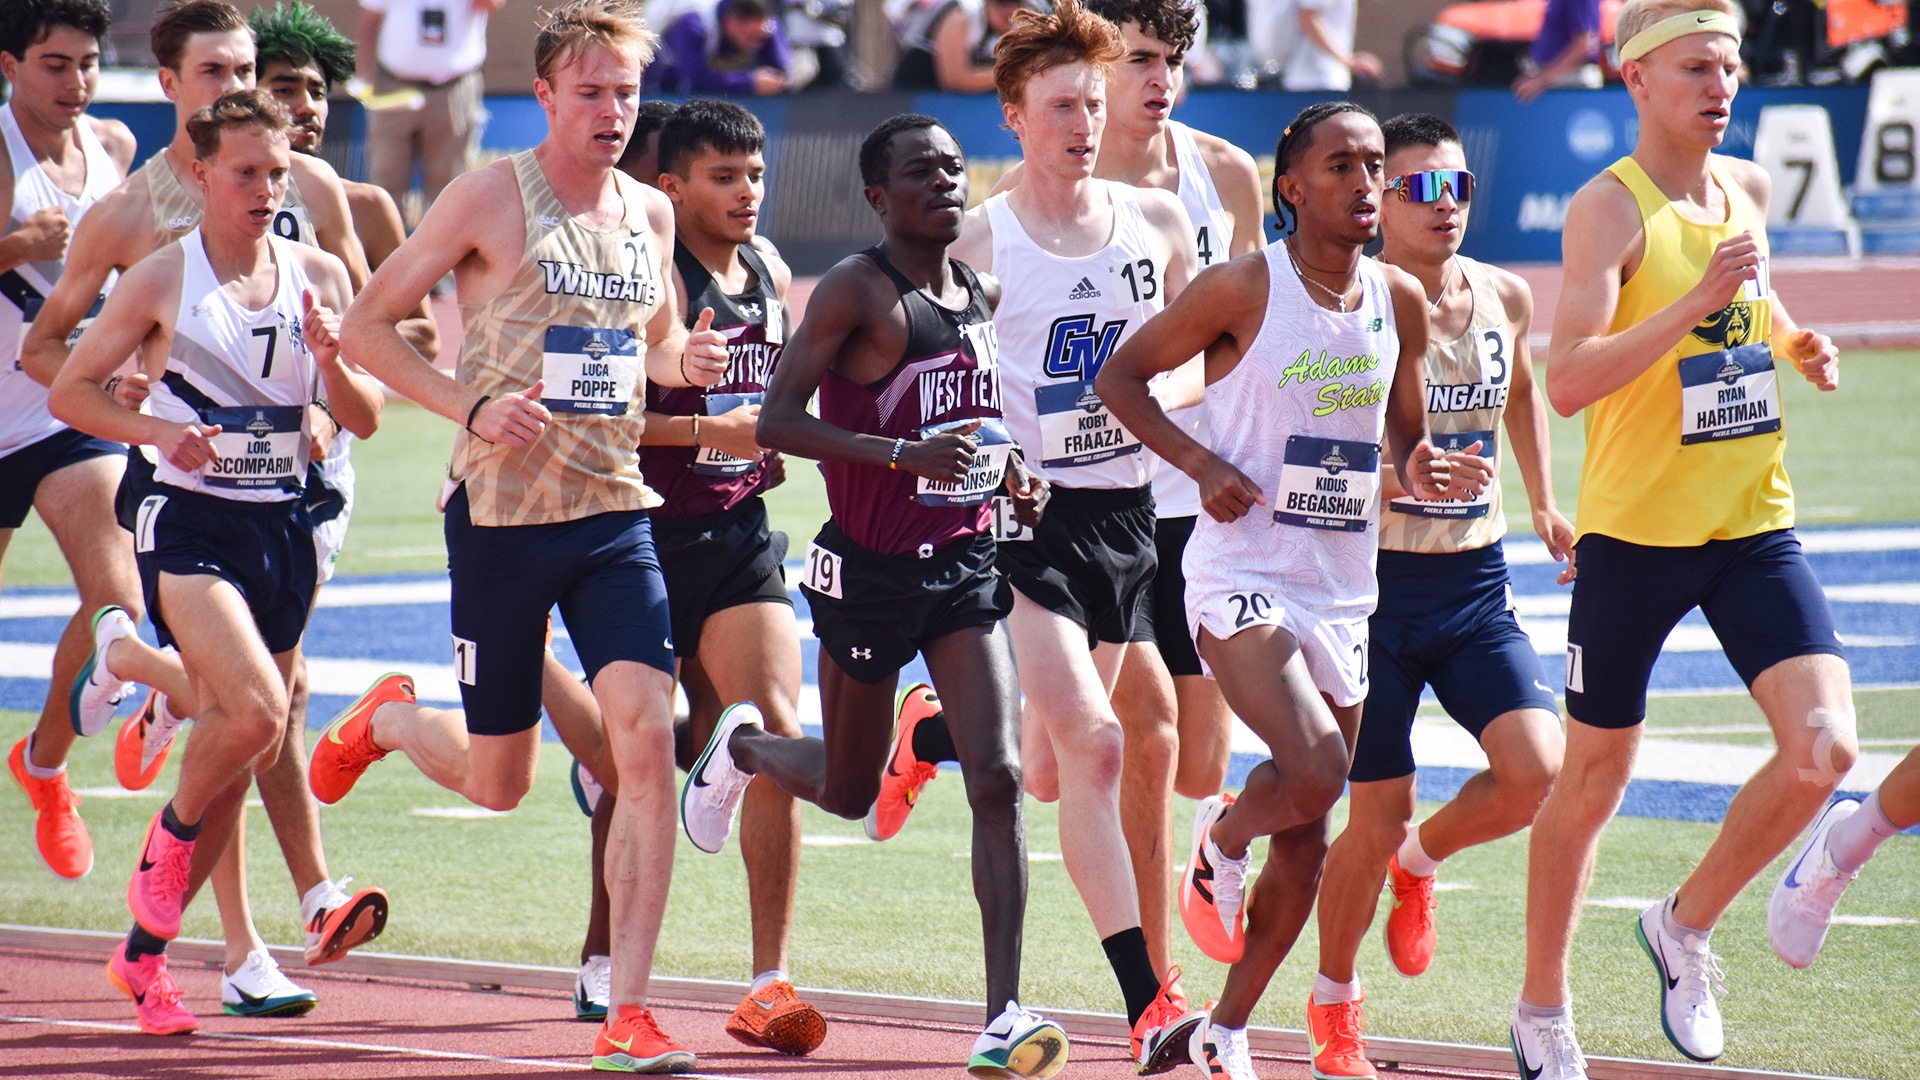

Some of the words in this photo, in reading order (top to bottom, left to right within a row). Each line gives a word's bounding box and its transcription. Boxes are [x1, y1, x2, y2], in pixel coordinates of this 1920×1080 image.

[1875, 121, 1915, 183] 8
[1785, 160, 1815, 220] 7
[273, 210, 300, 242] 9
[624, 241, 653, 281] 21
[1196, 226, 1213, 265] 4
[537, 259, 657, 307] WINGATE
[1069, 289, 1101, 300] adidas
[1120, 258, 1157, 303] 13
[251, 326, 277, 378] 7
[1043, 313, 1129, 380] GV
[1483, 330, 1506, 385] 3
[582, 362, 609, 377] LUCA
[1278, 348, 1381, 389] Adams
[571, 379, 617, 398] POPPE
[919, 369, 967, 425] WEST
[1313, 378, 1388, 417] State
[1424, 379, 1508, 413] INGATE
[1717, 385, 1746, 404] RYAN
[1078, 413, 1109, 431] KOBY
[1696, 399, 1768, 430] HARTMAN
[247, 441, 271, 455] LOIC
[1064, 428, 1124, 454] FRAAZA
[212, 456, 294, 475] SCOMPARIN
[1315, 476, 1348, 493] KIDUS
[1286, 492, 1365, 516] BEGASHAW
[140, 499, 159, 549] 7
[810, 548, 834, 593] 19
[1227, 592, 1272, 629] 20
